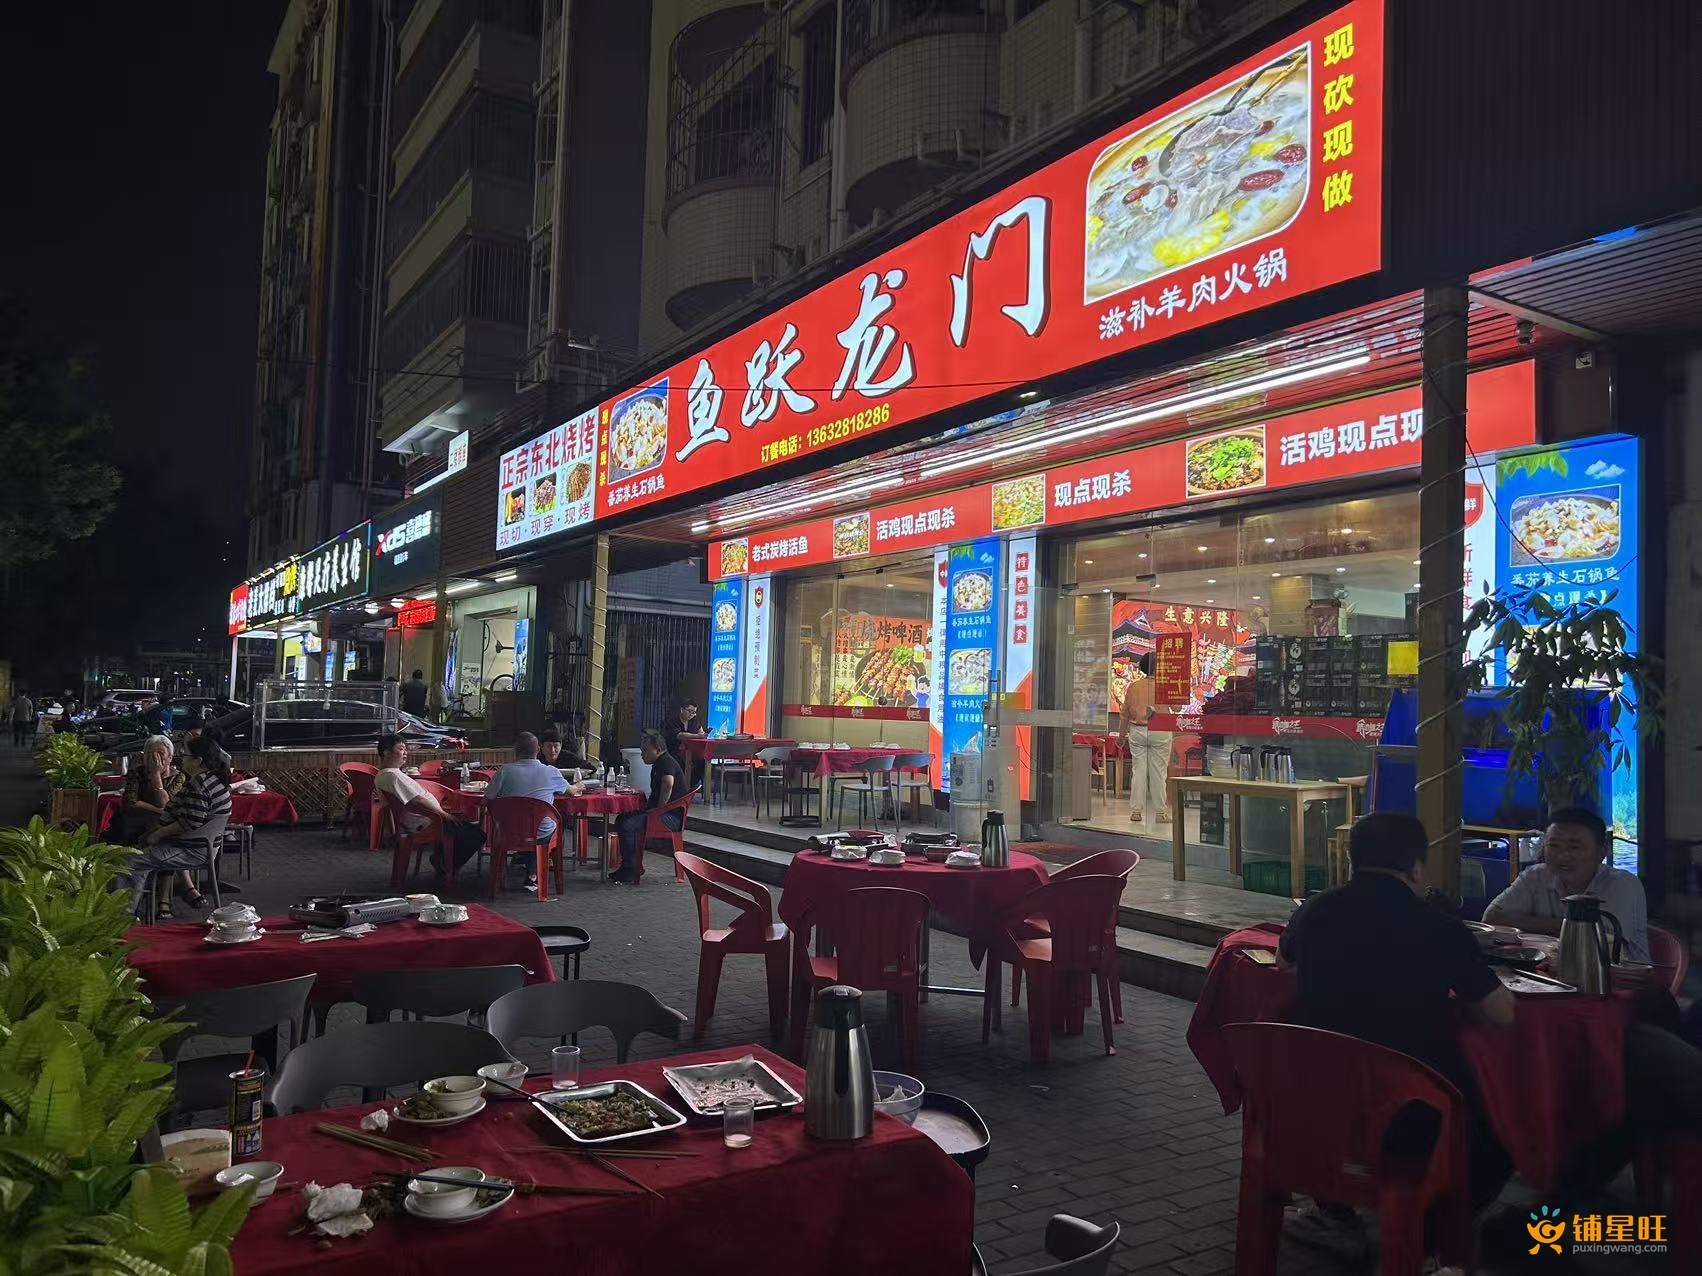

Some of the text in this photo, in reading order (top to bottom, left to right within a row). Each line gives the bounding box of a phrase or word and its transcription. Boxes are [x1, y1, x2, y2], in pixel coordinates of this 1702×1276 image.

[1321, 22, 1354, 213] 现砍现做
[1098, 247, 1288, 341] 滋补羊肉火锅
[675, 194, 1052, 464] 鱼跃龙门
[501, 414, 596, 491] 正宗东北烧烤
[607, 472, 666, 508] 番茄养生石锅鱼
[1053, 469, 1132, 508] 现点现杀
[875, 505, 956, 542] 活鸡现点现杀
[751, 535, 809, 563] 老式炭烤活鱼
[1164, 605, 1230, 627] 生意兴隆
[1163, 637, 1184, 649] 招聘
